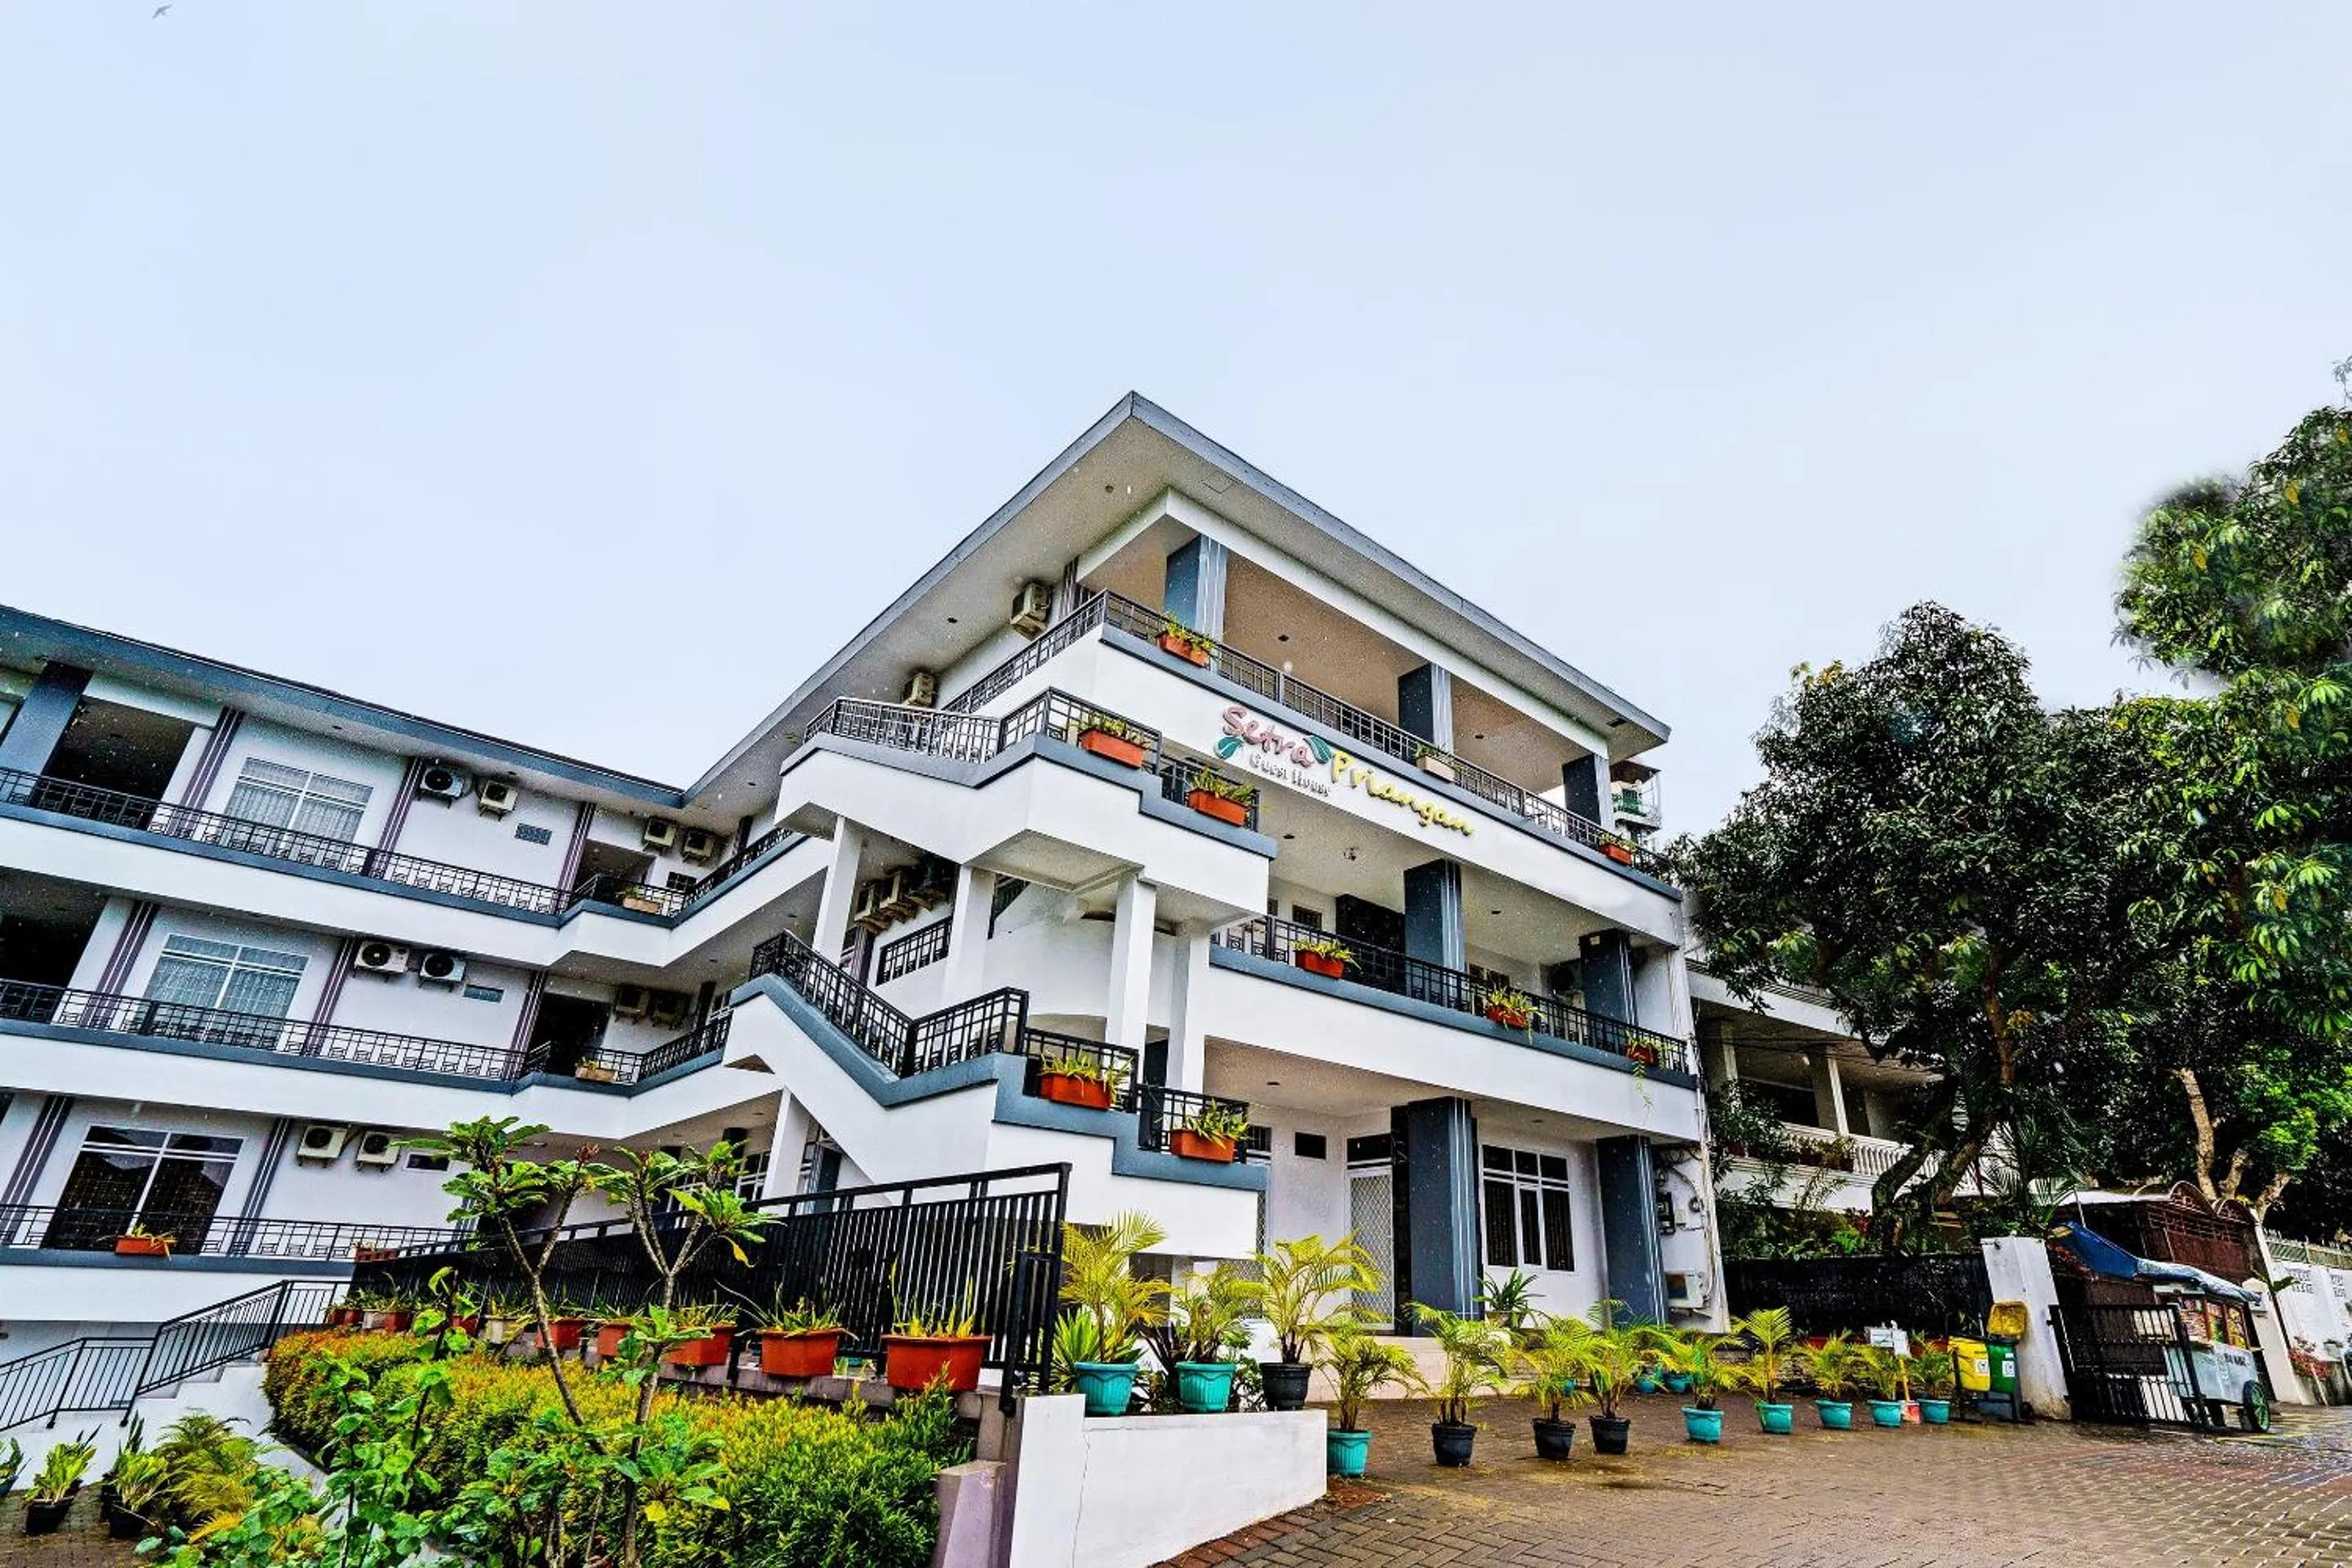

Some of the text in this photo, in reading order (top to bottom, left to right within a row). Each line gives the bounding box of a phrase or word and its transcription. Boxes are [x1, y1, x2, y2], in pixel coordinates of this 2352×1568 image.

[1222, 706, 1474, 835] Setra Priangan
[1250, 754, 1331, 796] Guest House
